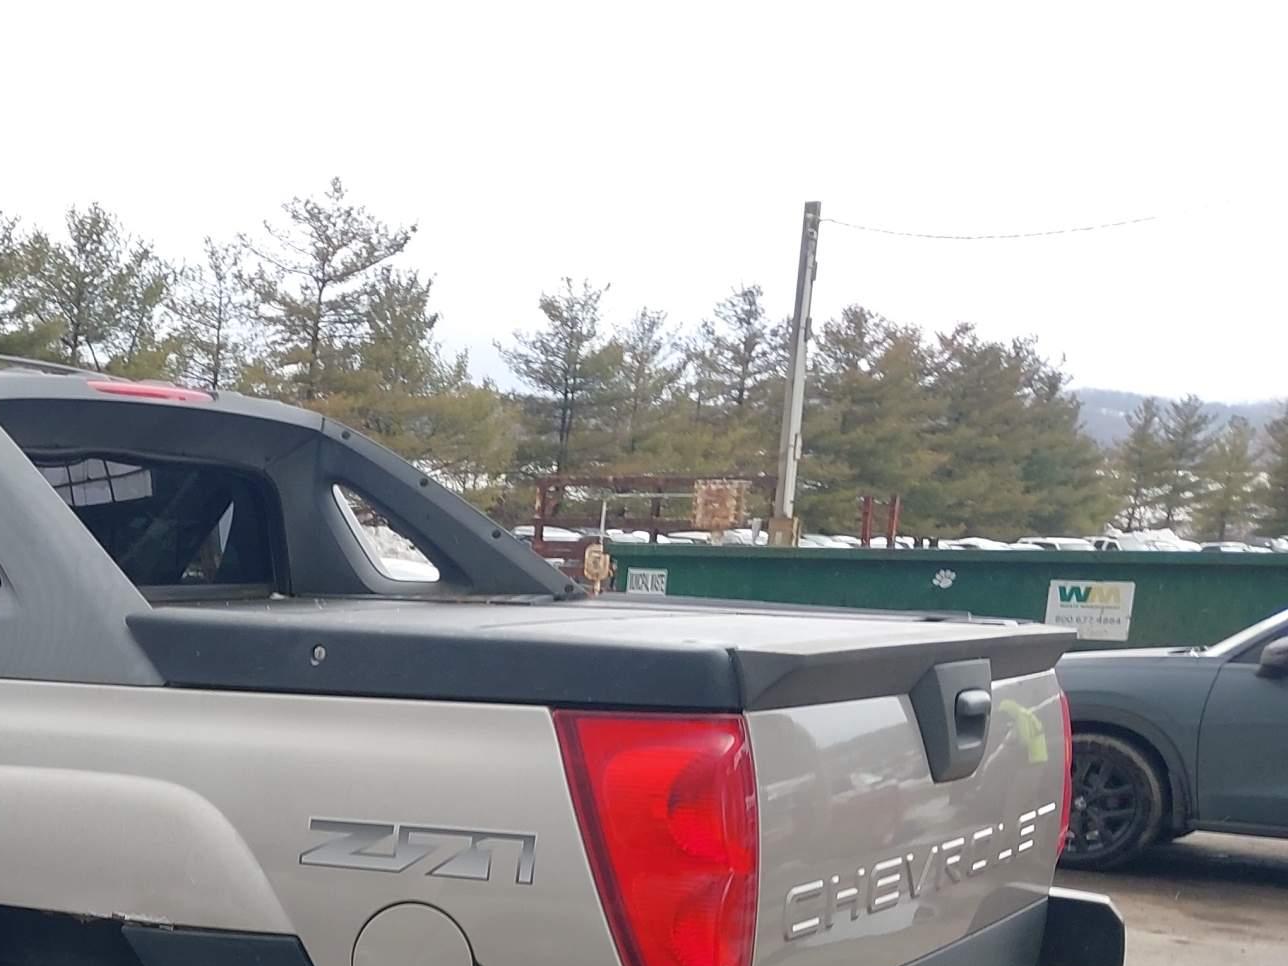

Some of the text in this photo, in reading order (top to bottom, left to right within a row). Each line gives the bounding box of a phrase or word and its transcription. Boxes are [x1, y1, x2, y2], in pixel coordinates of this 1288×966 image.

[1057, 585, 1121, 604] WM
[299, 816, 537, 885] Z71
[784, 802, 1056, 942] CHEVROLET
